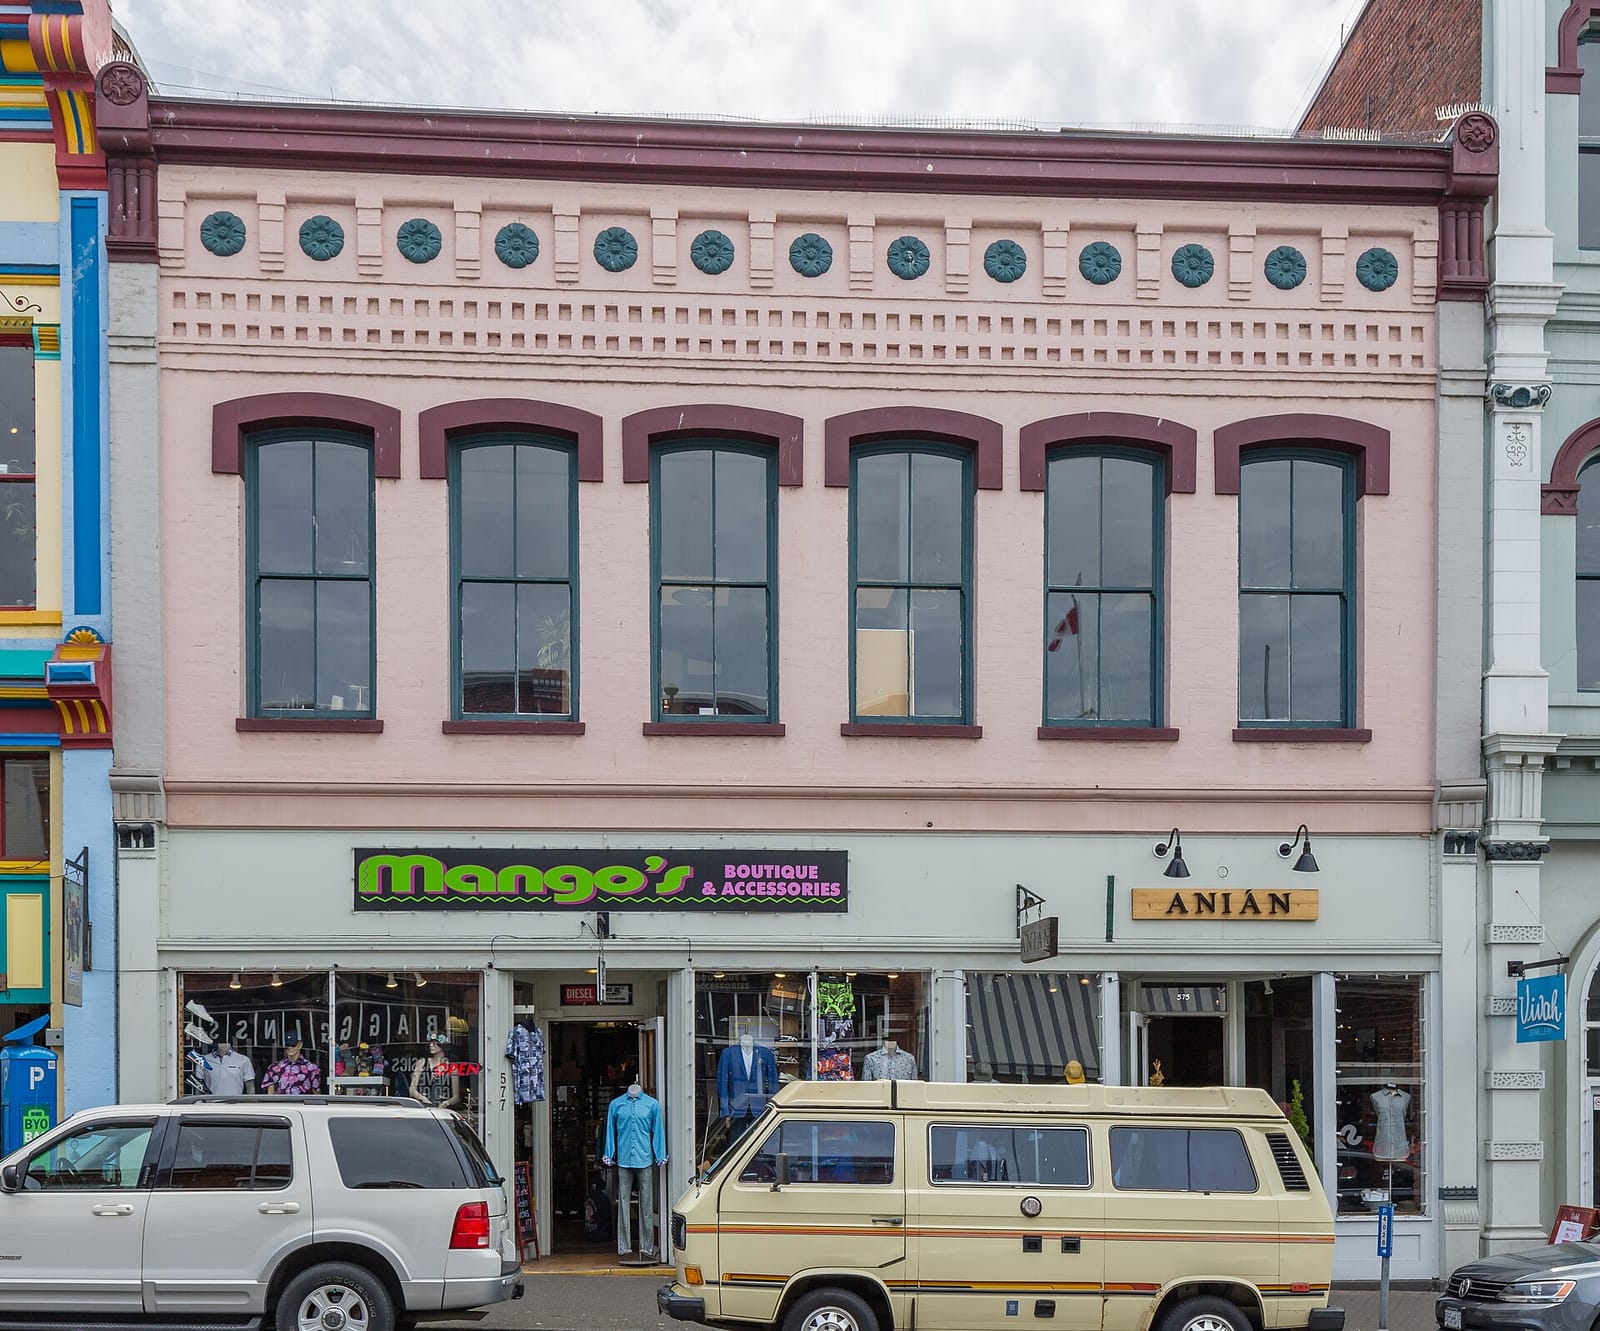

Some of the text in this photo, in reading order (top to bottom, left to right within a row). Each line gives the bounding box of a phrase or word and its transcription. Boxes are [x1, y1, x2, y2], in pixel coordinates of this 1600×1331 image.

[724, 864, 818, 880] BOUTIQUE
[701, 881, 841, 897] & ACCESSORIES
[1165, 888, 1292, 914] ANIÁN
[566, 988, 593, 999] DIESEL
[1176, 993, 1191, 1001] 575
[433, 1062, 481, 1077] OPEN
[30, 1066, 45, 1090] P
[24, 1119, 48, 1130] BYO
[24, 1131, 46, 1143] BA
